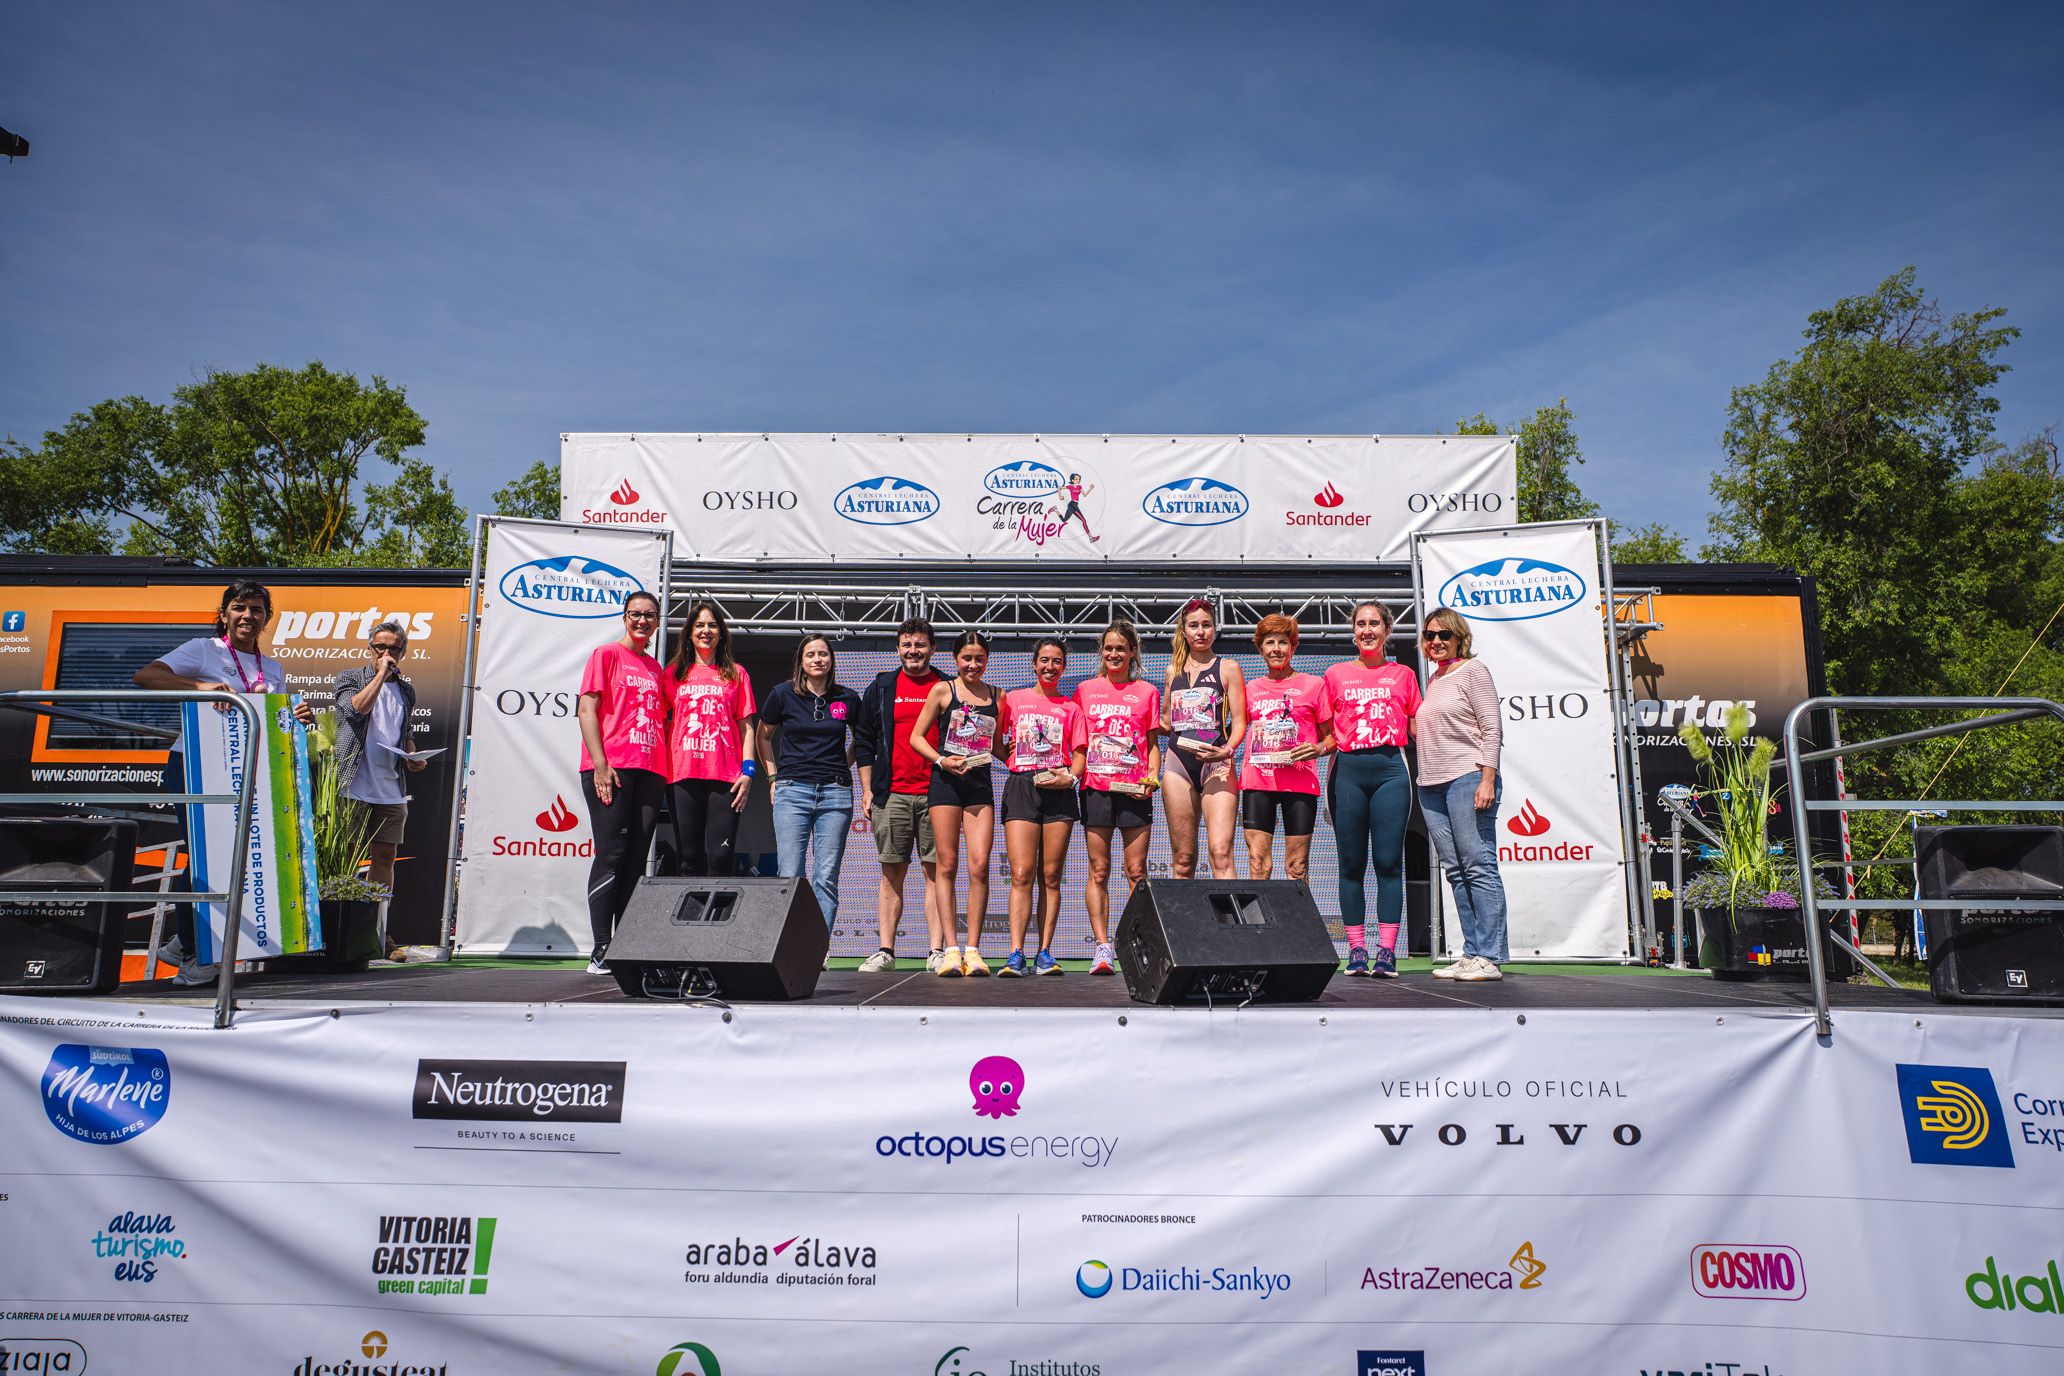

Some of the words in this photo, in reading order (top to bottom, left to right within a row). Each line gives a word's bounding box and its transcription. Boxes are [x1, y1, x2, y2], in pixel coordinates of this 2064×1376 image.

[990, 475, 1059, 489] ASTURIANA
[703, 490, 798, 511] OYSHO
[842, 494, 932, 513] ASTURIANA
[977, 495, 1043, 516] Carrera
[1152, 495, 1241, 514] ASTURIANA
[1407, 493, 1502, 513] OYSHO
[582, 509, 668, 524] Santander
[1285, 511, 1372, 526] Santander
[992, 517, 1005, 530] de
[1008, 517, 1017, 530] la
[1015, 514, 1068, 546] Mujer
[534, 574, 580, 584] CENTRAL
[585, 578, 631, 588] LECHERA
[1471, 579, 1517, 588] CENTRAL
[1521, 575, 1569, 585] LECHERA
[1450, 584, 1575, 608] ASTURIANA
[412, 649, 431, 660] SL.
[285, 673, 321, 686] Rampa
[298, 689, 336, 700] Tarima
[679, 685, 723, 697] CARRERA
[1344, 687, 1391, 701] CARRERA
[496, 690, 579, 718] OYS
[1089, 703, 1132, 717] CARRERA
[1370, 702, 1386, 720] DE
[1499, 692, 1589, 721] SHO
[1611, 695, 1757, 728] ortos
[228, 708, 241, 763] CENTRAL
[682, 736, 717, 752] MUJER
[492, 836, 597, 858] Santand
[1498, 841, 1594, 862] ntander
[251, 852, 262, 869] DE
[253, 872, 268, 948] PRODUCTOS
[2008, 972, 2023, 984] EV
[40, 1017, 56, 1026] DEL
[57, 1018, 97, 1027] CIRCUITO
[47, 1066, 163, 1117] Marlene
[427, 1072, 610, 1116] Neutrogena
[1381, 1077, 1512, 1098] VEHÍCULO
[1525, 1081, 1628, 1098] OFICIAL
[55, 1113, 75, 1133] HIJA
[77, 1126, 89, 1138] DE
[91, 1131, 108, 1140] LOS
[110, 1119, 145, 1140] ALPES
[457, 1130, 498, 1140] BEAUTY
[502, 1132, 515, 1140] TO
[519, 1132, 526, 1140] A
[529, 1132, 576, 1142] SCIENCE
[1374, 1123, 1642, 1146] VOLVO
[876, 1131, 1006, 1164] octopus
[1010, 1136, 1119, 1168] energy
[108, 1210, 176, 1234] alava
[1081, 1214, 1159, 1224] PATROCINADORES
[1160, 1215, 1196, 1224] BRONCE
[378, 1216, 472, 1245] VITORIA
[371, 1247, 470, 1276] GASTEIZ
[686, 1237, 768, 1267] araba
[794, 1237, 877, 1268] álava
[114, 1260, 159, 1283] eus
[685, 1271, 710, 1283] foru
[714, 1272, 769, 1284] aldundia
[776, 1272, 844, 1287] diputación
[847, 1274, 876, 1286] foral
[1360, 1267, 1513, 1290] AstraZeneca
[1700, 1251, 1795, 1291] COSMO
[377, 1278, 415, 1295] green
[418, 1278, 466, 1296] capital
[1122, 1266, 1292, 1300] Daiichi-Sankyo
[6, 1312, 45, 1321] CARRERA
[46, 1312, 59, 1321] DE
[60, 1312, 71, 1321] LA
[72, 1312, 102, 1321] MUJER
[103, 1313, 115, 1321] DE
[116, 1313, 189, 1323] VITORIA-GASTEIZ
[1009, 1359, 1101, 1376] Institutos
